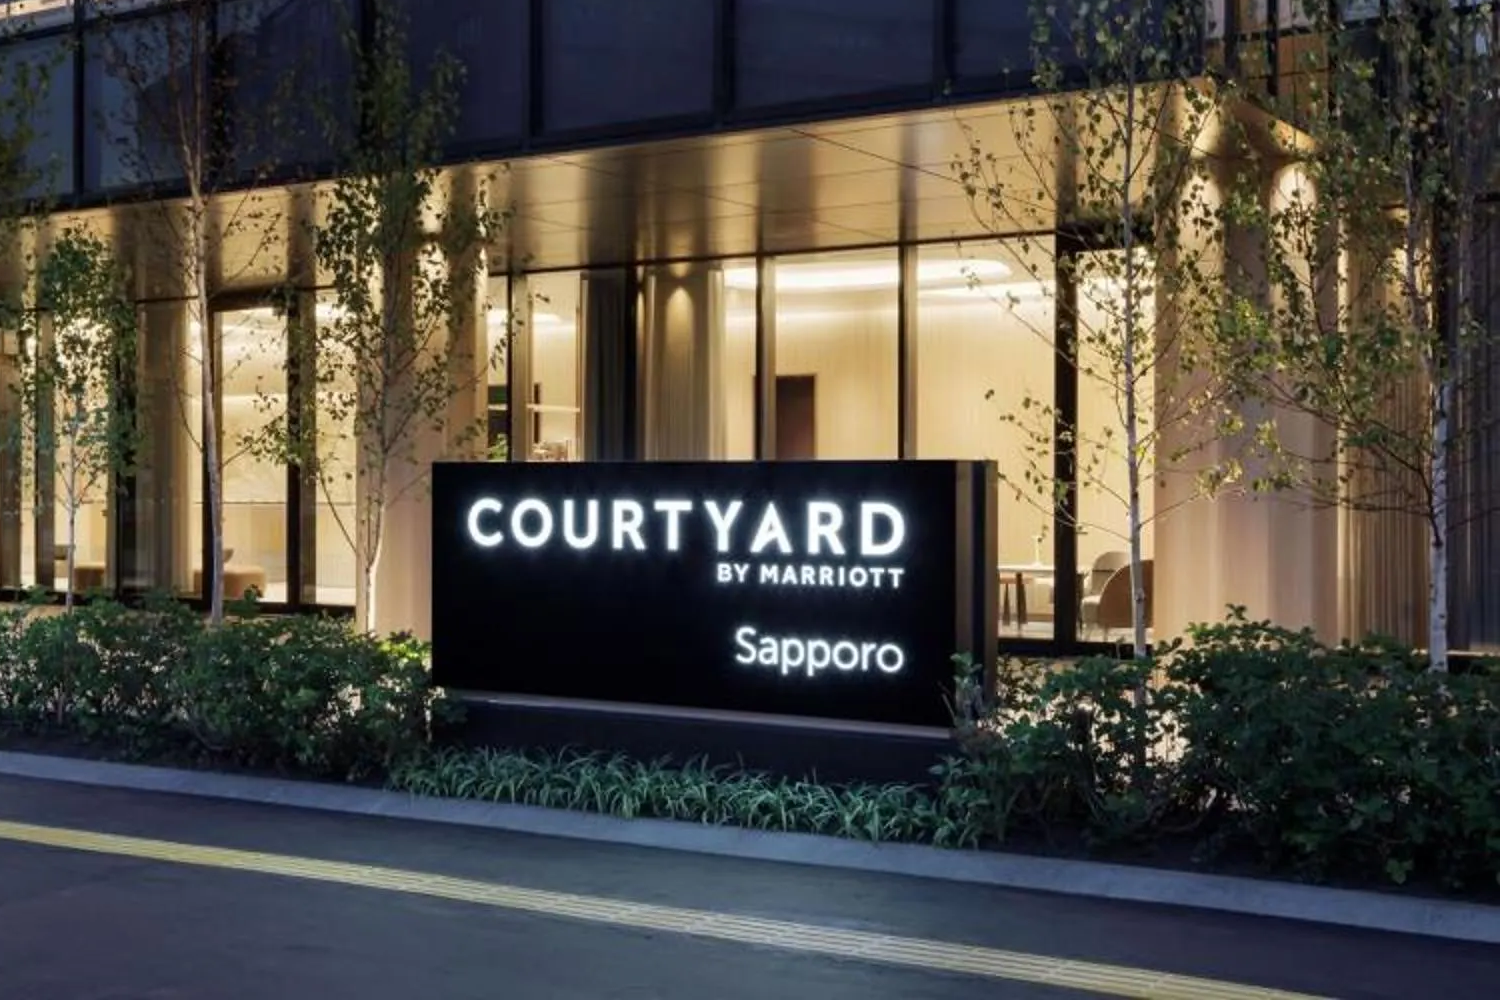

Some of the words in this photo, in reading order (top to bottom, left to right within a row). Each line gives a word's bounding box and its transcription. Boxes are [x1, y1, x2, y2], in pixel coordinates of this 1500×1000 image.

[466, 496, 906, 557] COURTYARD
[716, 562, 750, 584] BY
[759, 563, 905, 589] MARRIOTT
[734, 625, 905, 677] Sapporo
